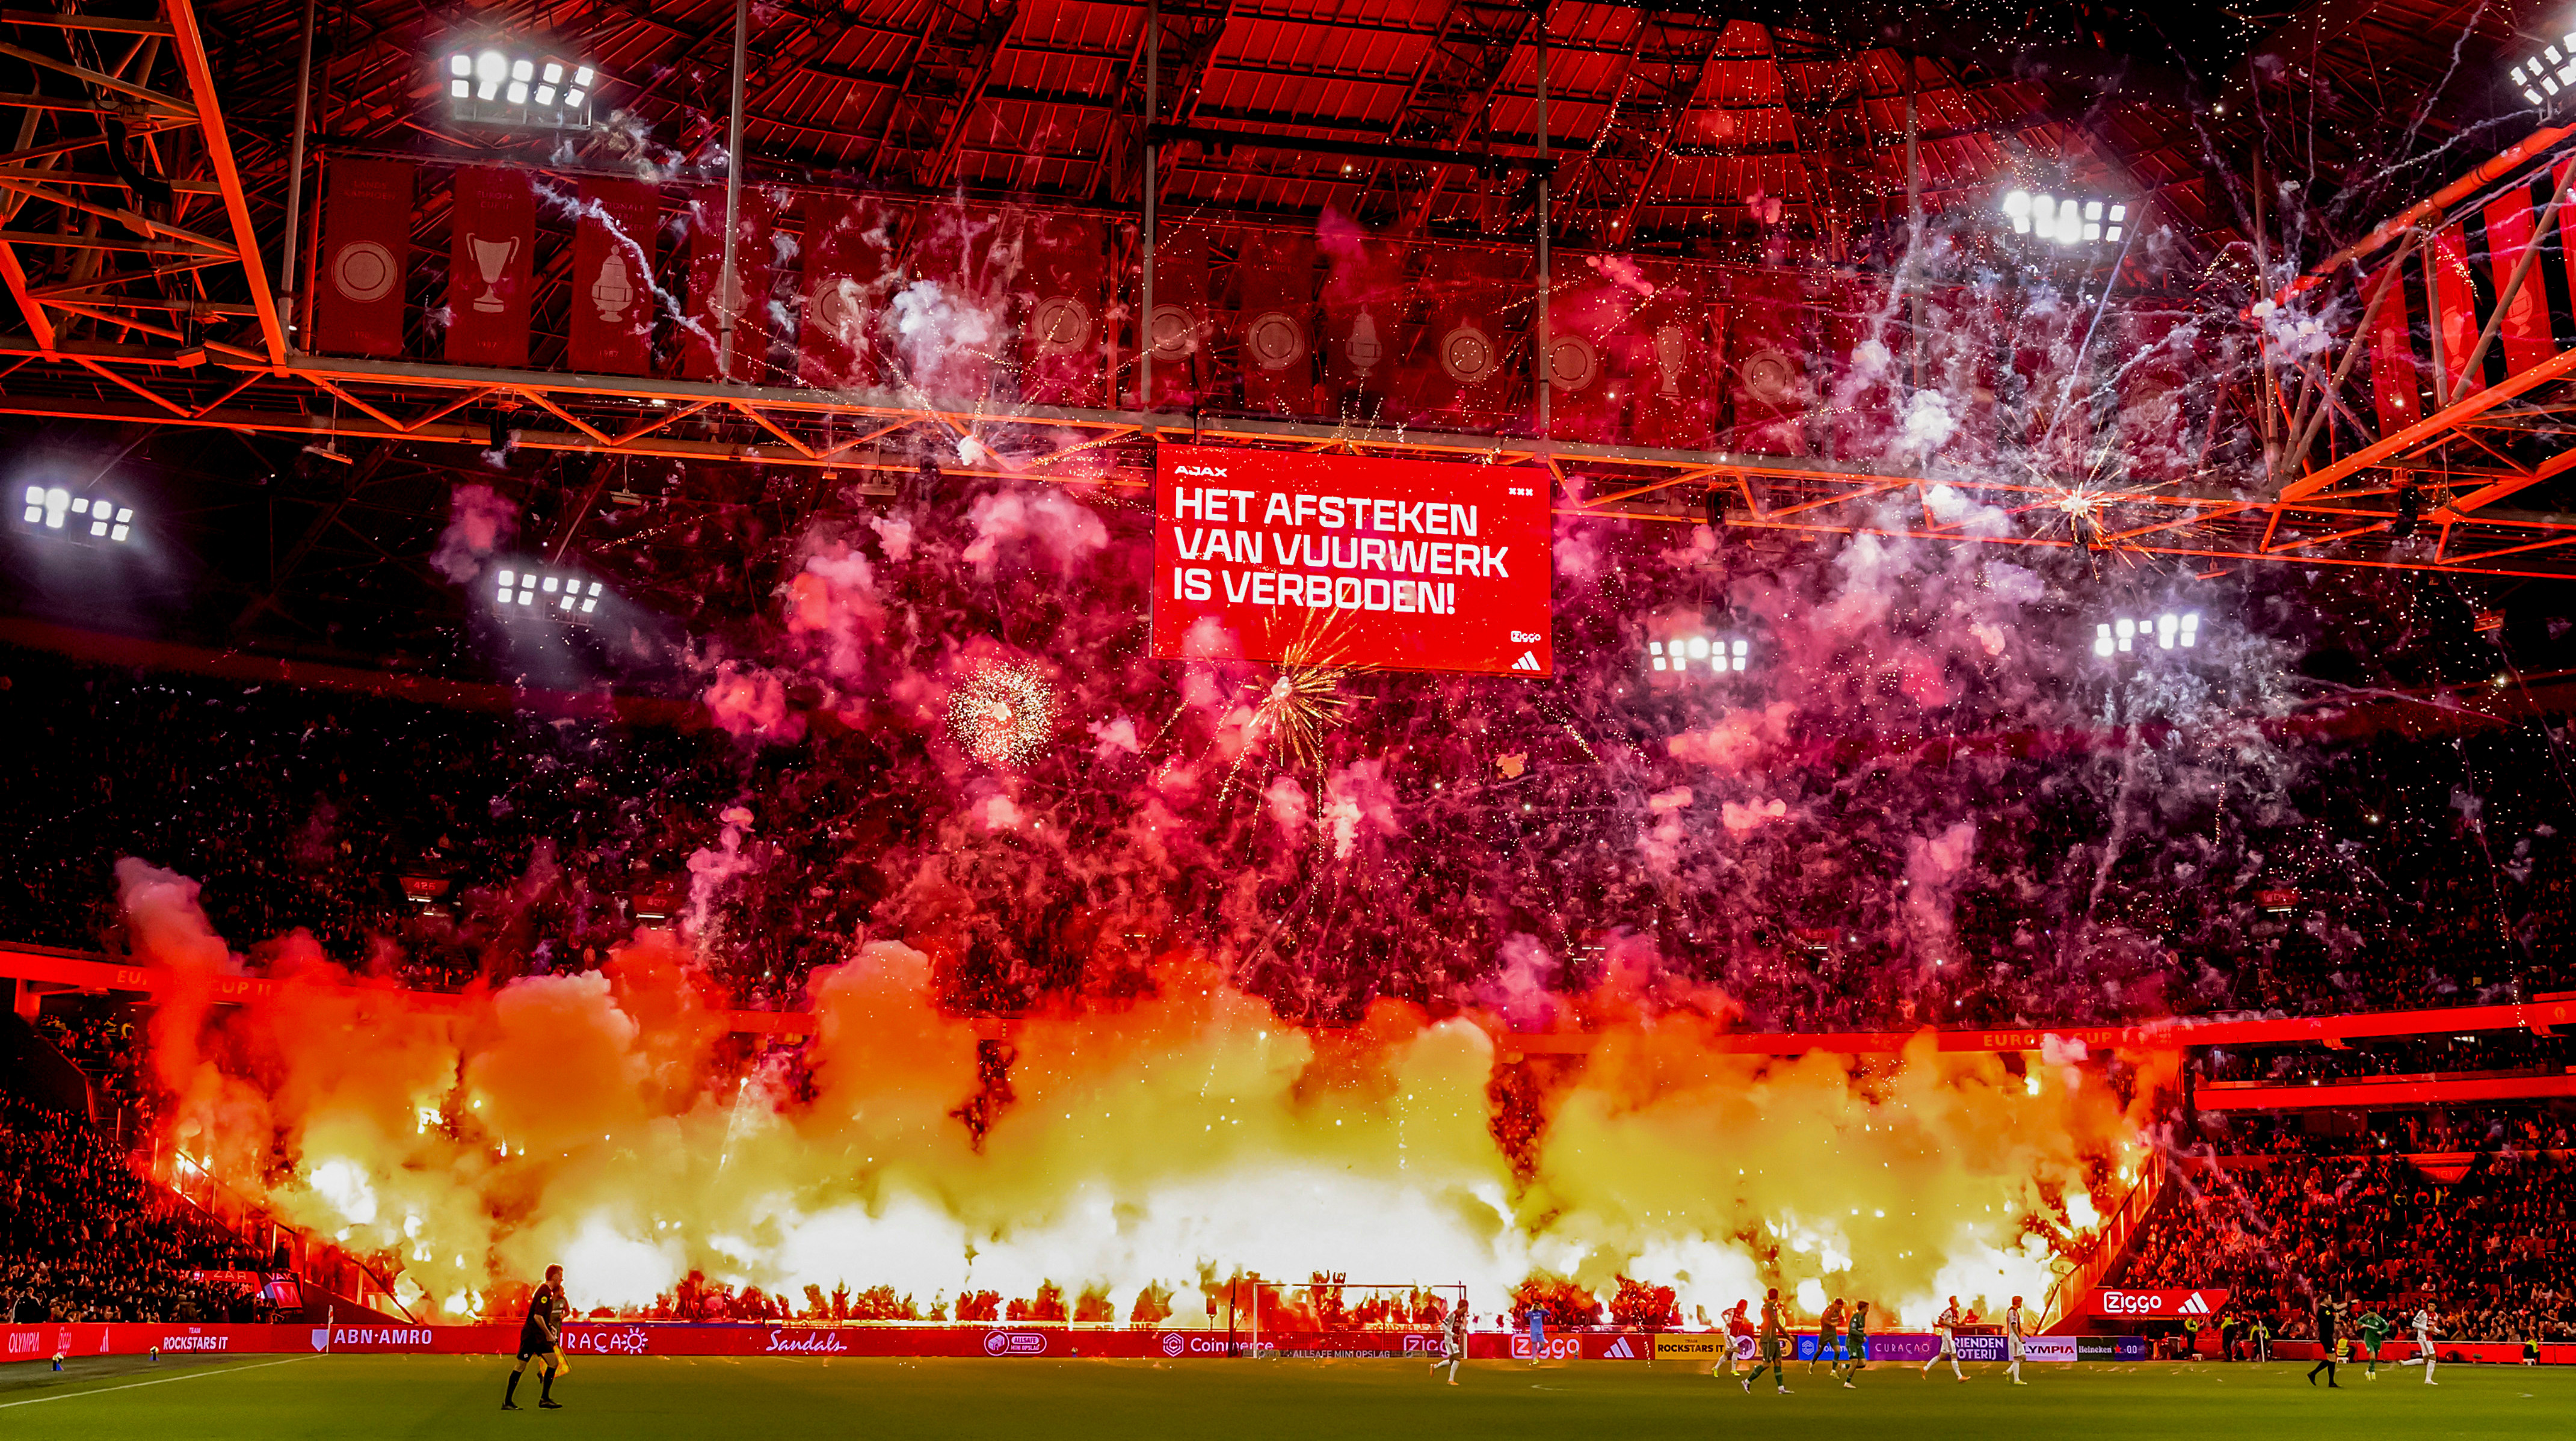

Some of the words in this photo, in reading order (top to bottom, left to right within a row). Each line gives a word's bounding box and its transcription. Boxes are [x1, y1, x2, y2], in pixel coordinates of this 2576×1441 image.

[1174, 465, 1227, 478] AJAX
[1176, 487, 1255, 523] HET
[1264, 492, 1478, 537] AFSTEKEN
[1174, 526, 1262, 564] VAN
[1273, 532, 1509, 578] VUURWERK
[1174, 567, 1212, 601] IS
[1222, 570, 1455, 615] VERBODEN!
[1984, 1033, 2044, 1046] EURO
[276, 1286, 299, 1303] M
[8, 1332, 40, 1353] OLYMPIA
[163, 1336, 217, 1350] ROCKSTARS
[218, 1336, 228, 1350] IT
[766, 1329, 848, 1352] Sandals
[1955, 1337, 2004, 1348] RIENDEN
[1293, 1350, 1332, 1358] ALLSAFE
[1355, 1350, 1390, 1359] OPSLAG
[1657, 1344, 1714, 1353] ROCKSTARS
[1716, 1344, 1724, 1353] IT
[1875, 1343, 1930, 1354] CURAÇAO
[1957, 1349, 1996, 1360] OTERIJ
[2025, 1345, 2074, 1354] LYMPIA
[2078, 1345, 2112, 1354] Heineken
